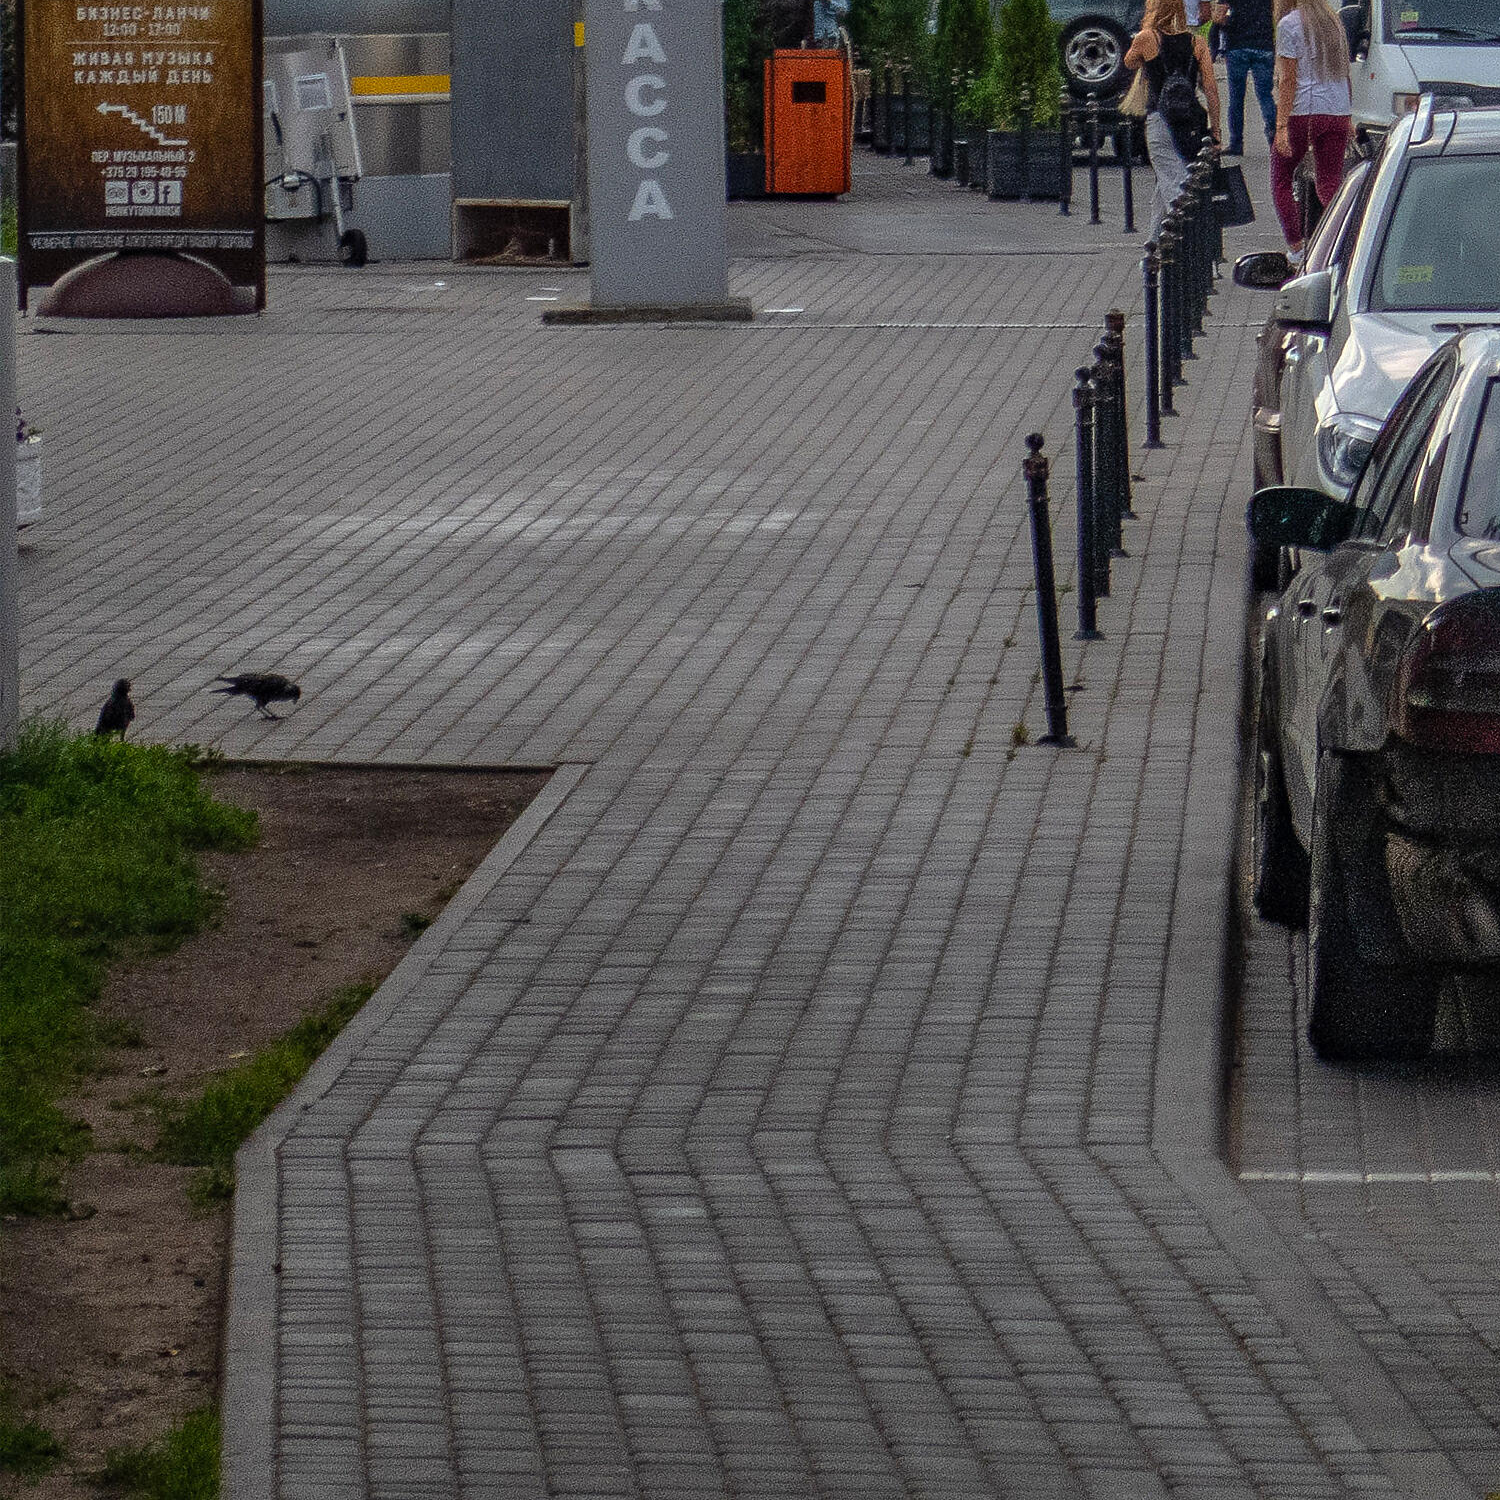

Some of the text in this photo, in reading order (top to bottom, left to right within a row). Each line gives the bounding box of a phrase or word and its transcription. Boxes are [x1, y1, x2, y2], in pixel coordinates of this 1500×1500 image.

[72, 50, 215, 66] ЖИВАЯ МУЗЫКА
[74, 65, 214, 85] КАЖДЫЙ ДЕНЬ
